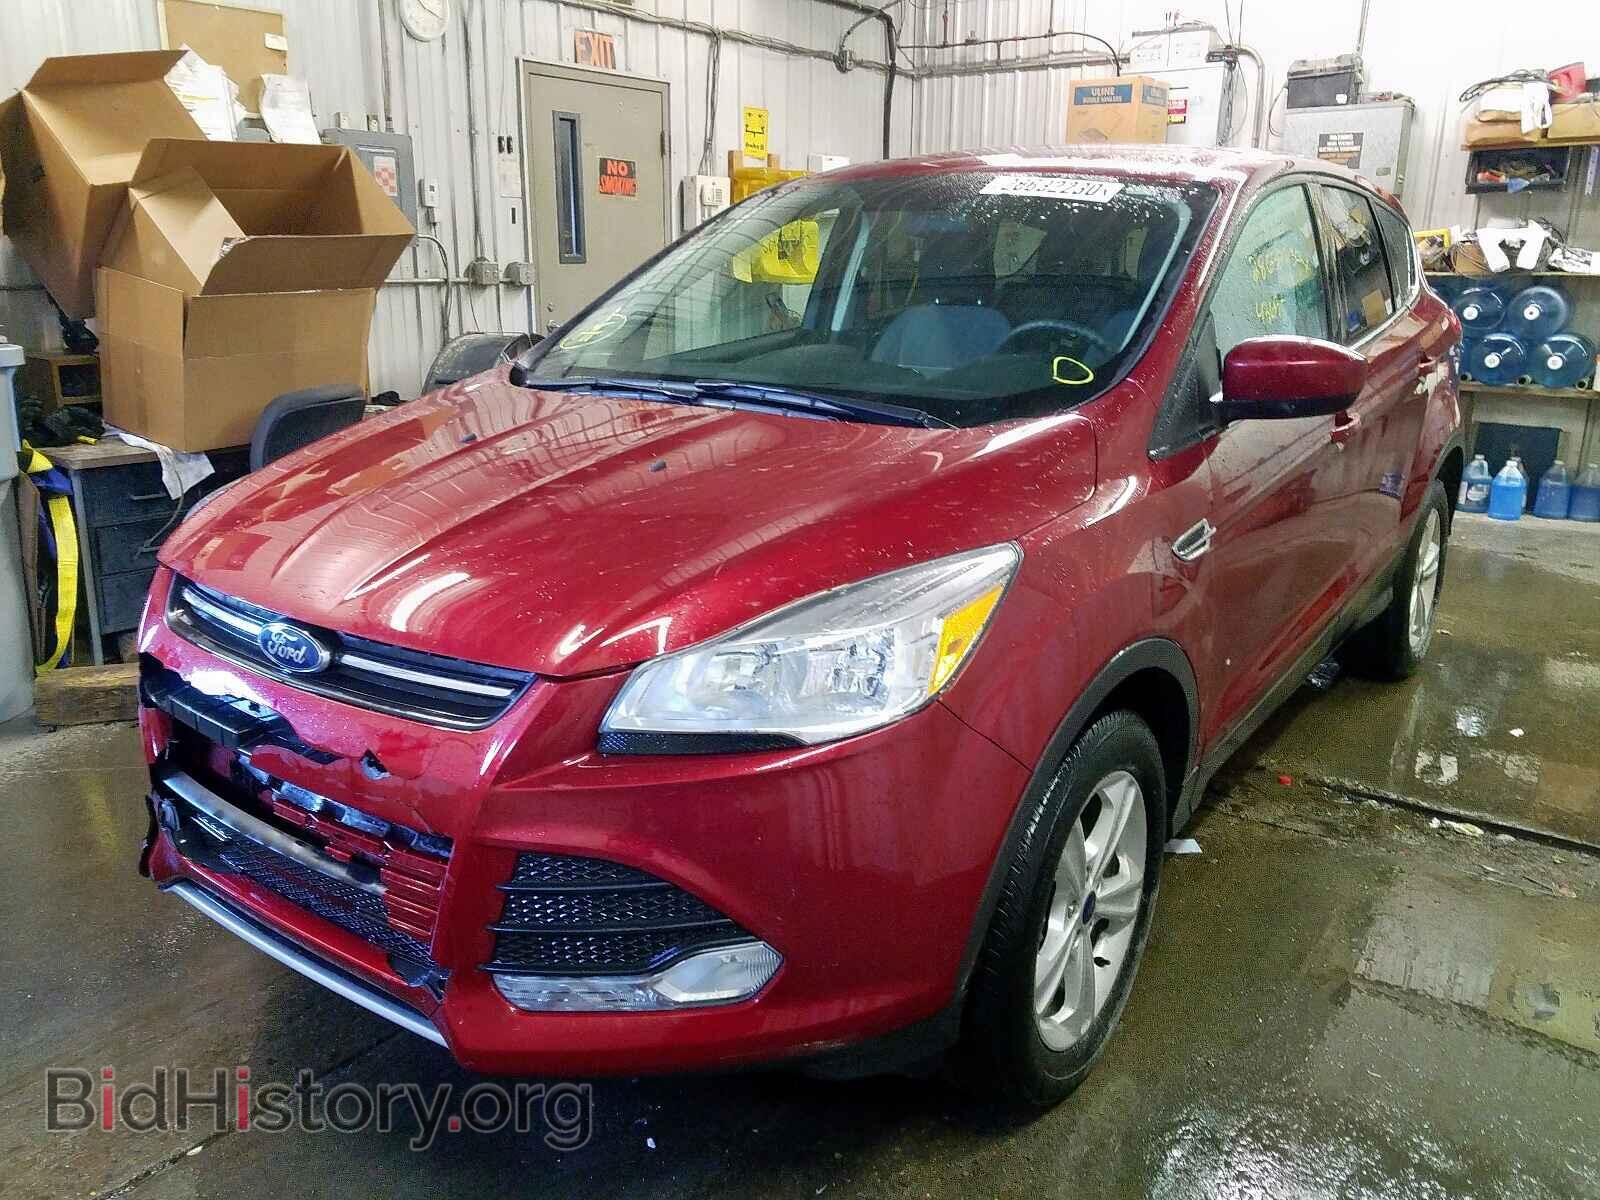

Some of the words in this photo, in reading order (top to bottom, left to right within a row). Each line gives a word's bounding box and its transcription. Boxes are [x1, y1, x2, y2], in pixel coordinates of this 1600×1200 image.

[575, 33, 615, 69] EXIT
[1091, 86, 1115, 97] ULINE
[606, 159, 628, 176] NO
[599, 174, 636, 194] SMOKING
[267, 629, 307, 664] Ford
